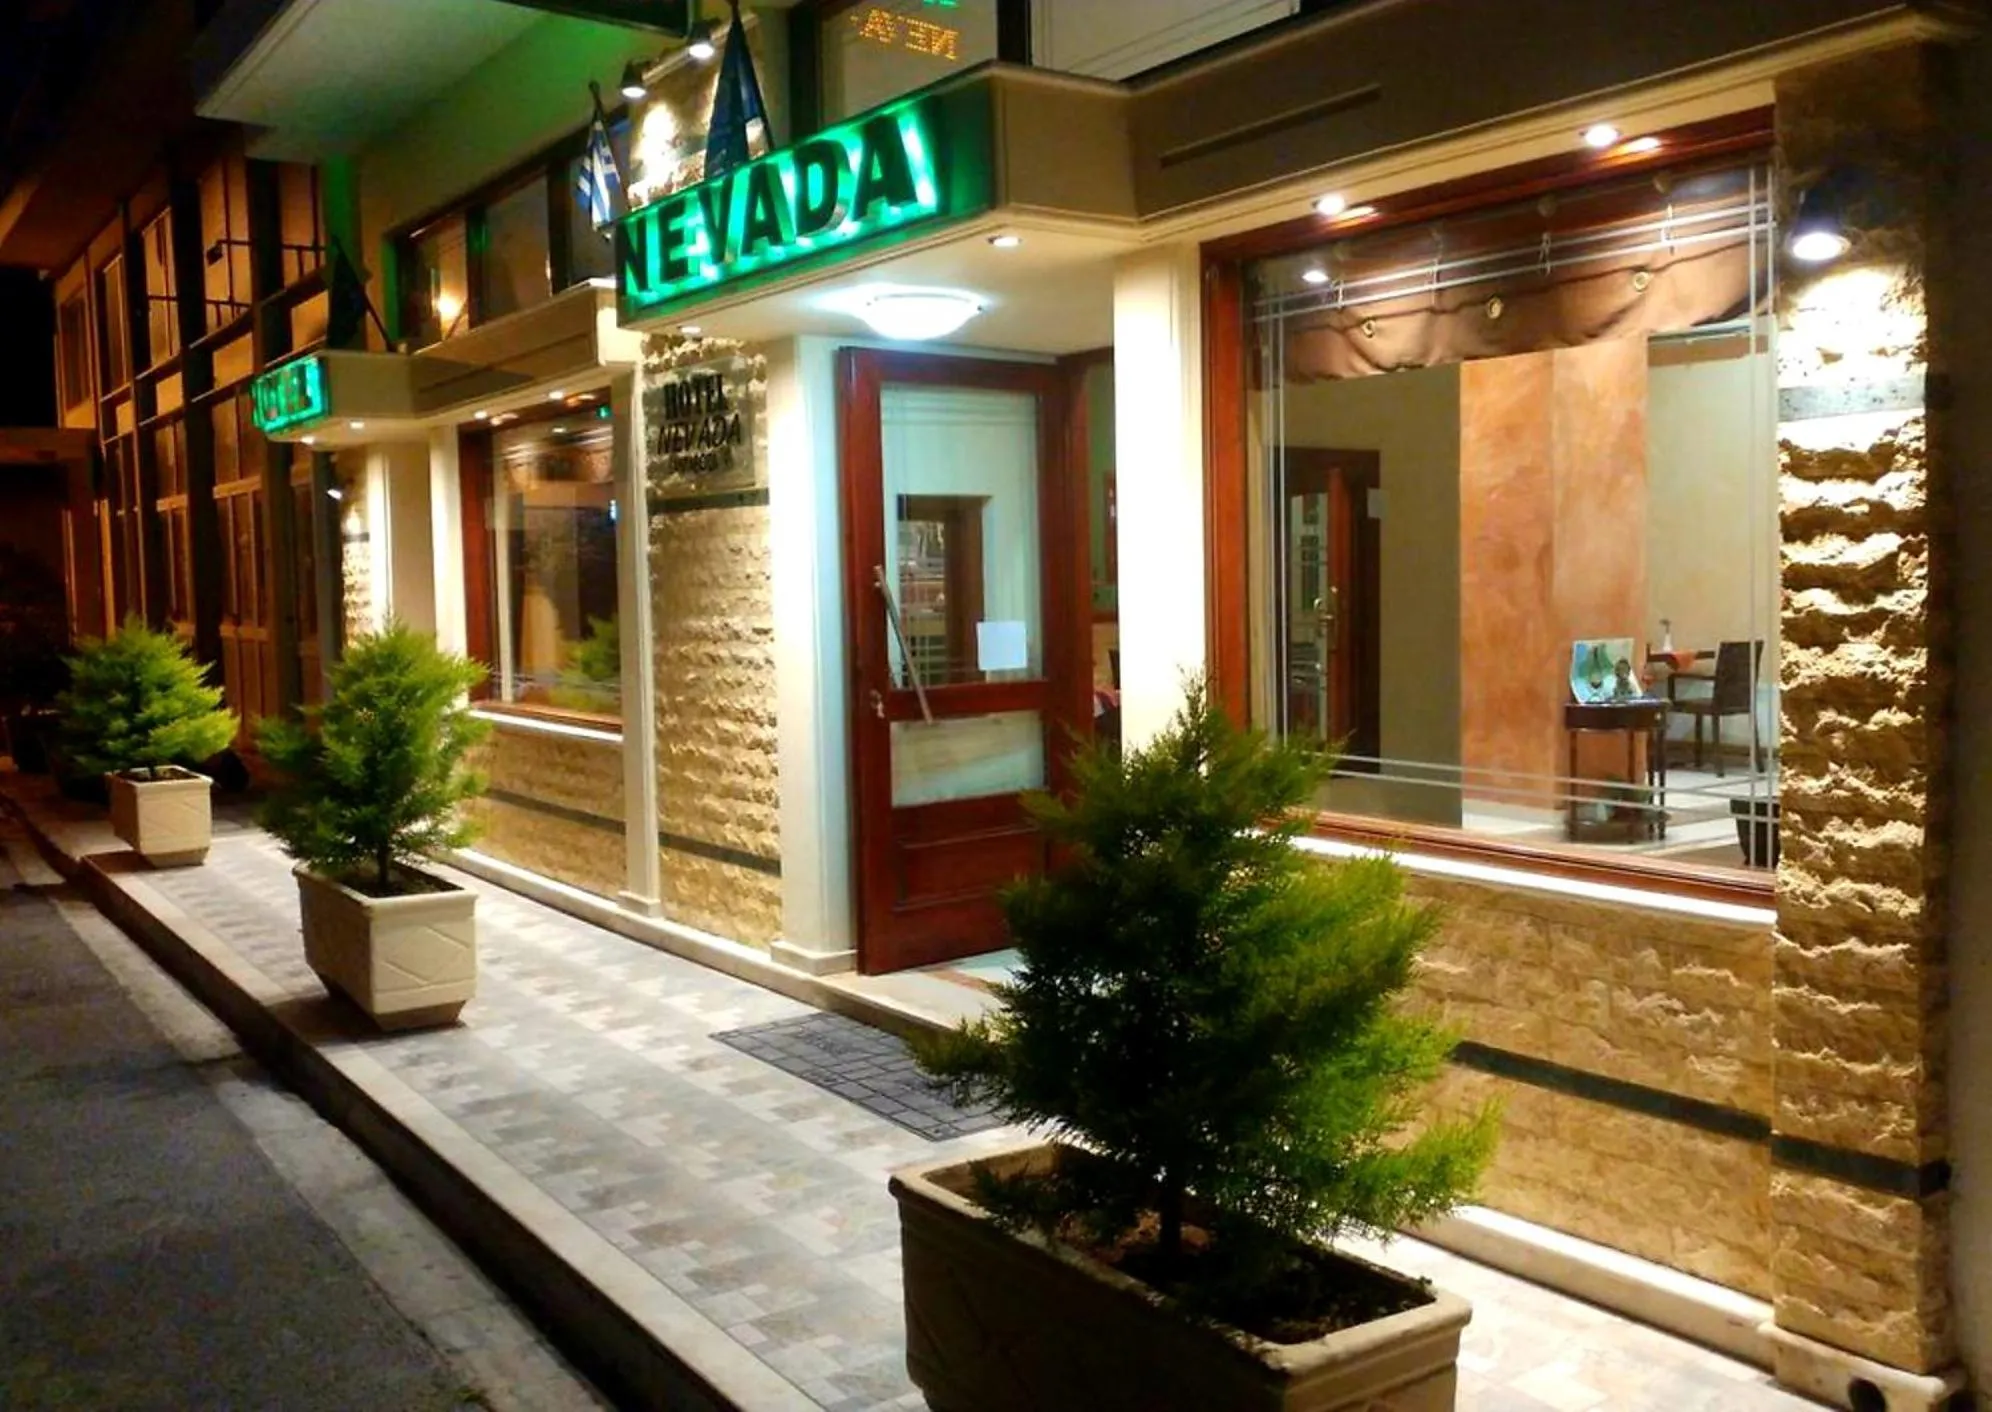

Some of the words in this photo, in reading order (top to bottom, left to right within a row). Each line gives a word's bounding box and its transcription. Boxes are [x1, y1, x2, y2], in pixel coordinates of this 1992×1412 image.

[614, 111, 919, 294] NEVADA
[663, 372, 728, 420] HOTEL
[657, 412, 742, 455] NEVADA
